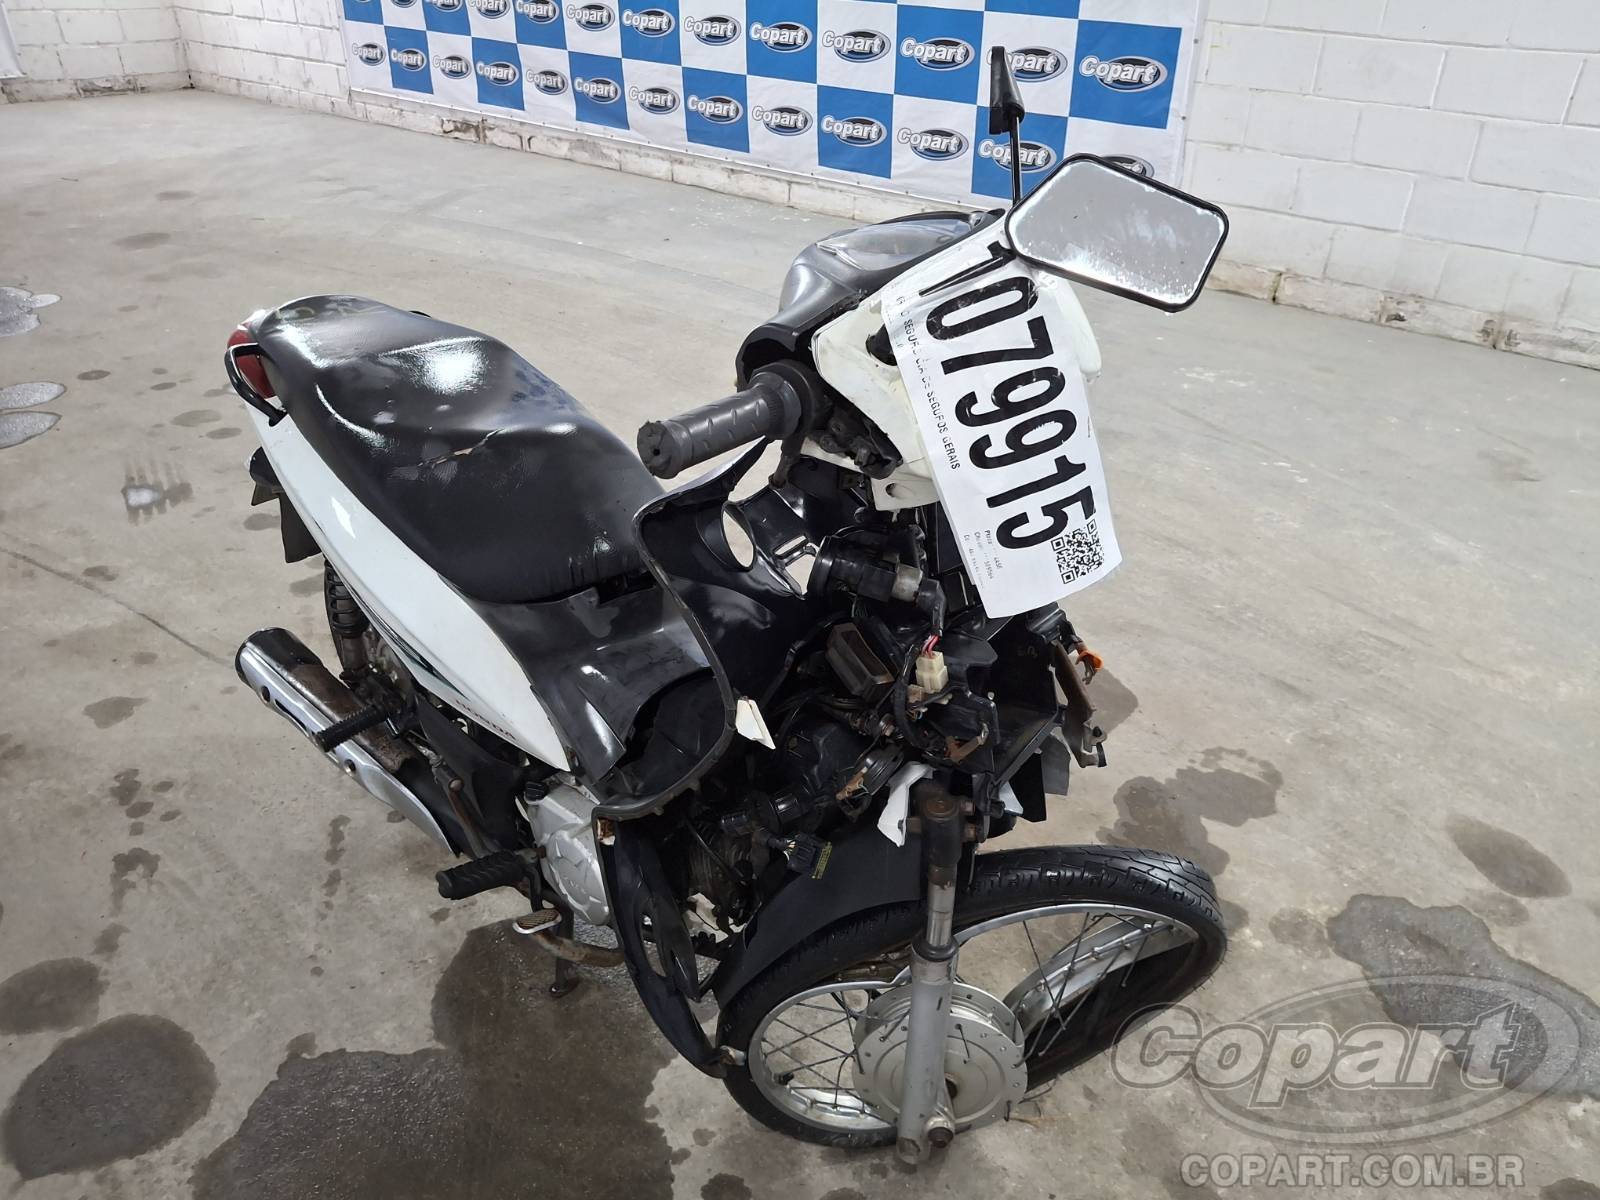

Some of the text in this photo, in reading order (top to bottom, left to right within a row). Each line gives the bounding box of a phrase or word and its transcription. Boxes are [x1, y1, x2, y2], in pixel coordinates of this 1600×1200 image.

[516, 0, 554, 17] Copart
[567, 5, 610, 23] Copart
[622, 9, 670, 31] Copart
[684, 16, 735, 38] Copart
[750, 22, 805, 45] Copart
[822, 30, 882, 53] Copart
[352, 43, 382, 61] Copart
[391, 49, 422, 66] Copart
[901, 37, 968, 64] Copart
[433, 55, 467, 74] Copart
[476, 61, 514, 80] Copart
[1079, 55, 1159, 83] Copart
[526, 69, 563, 89] Copart
[574, 77, 616, 98] Copart
[629, 86, 673, 107] Copart
[687, 95, 737, 118] Copart
[752, 106, 805, 128] Copart
[821, 115, 879, 139] Copart
[897, 127, 959, 153] Copart
[942, 436, 961, 470] GERAIS
